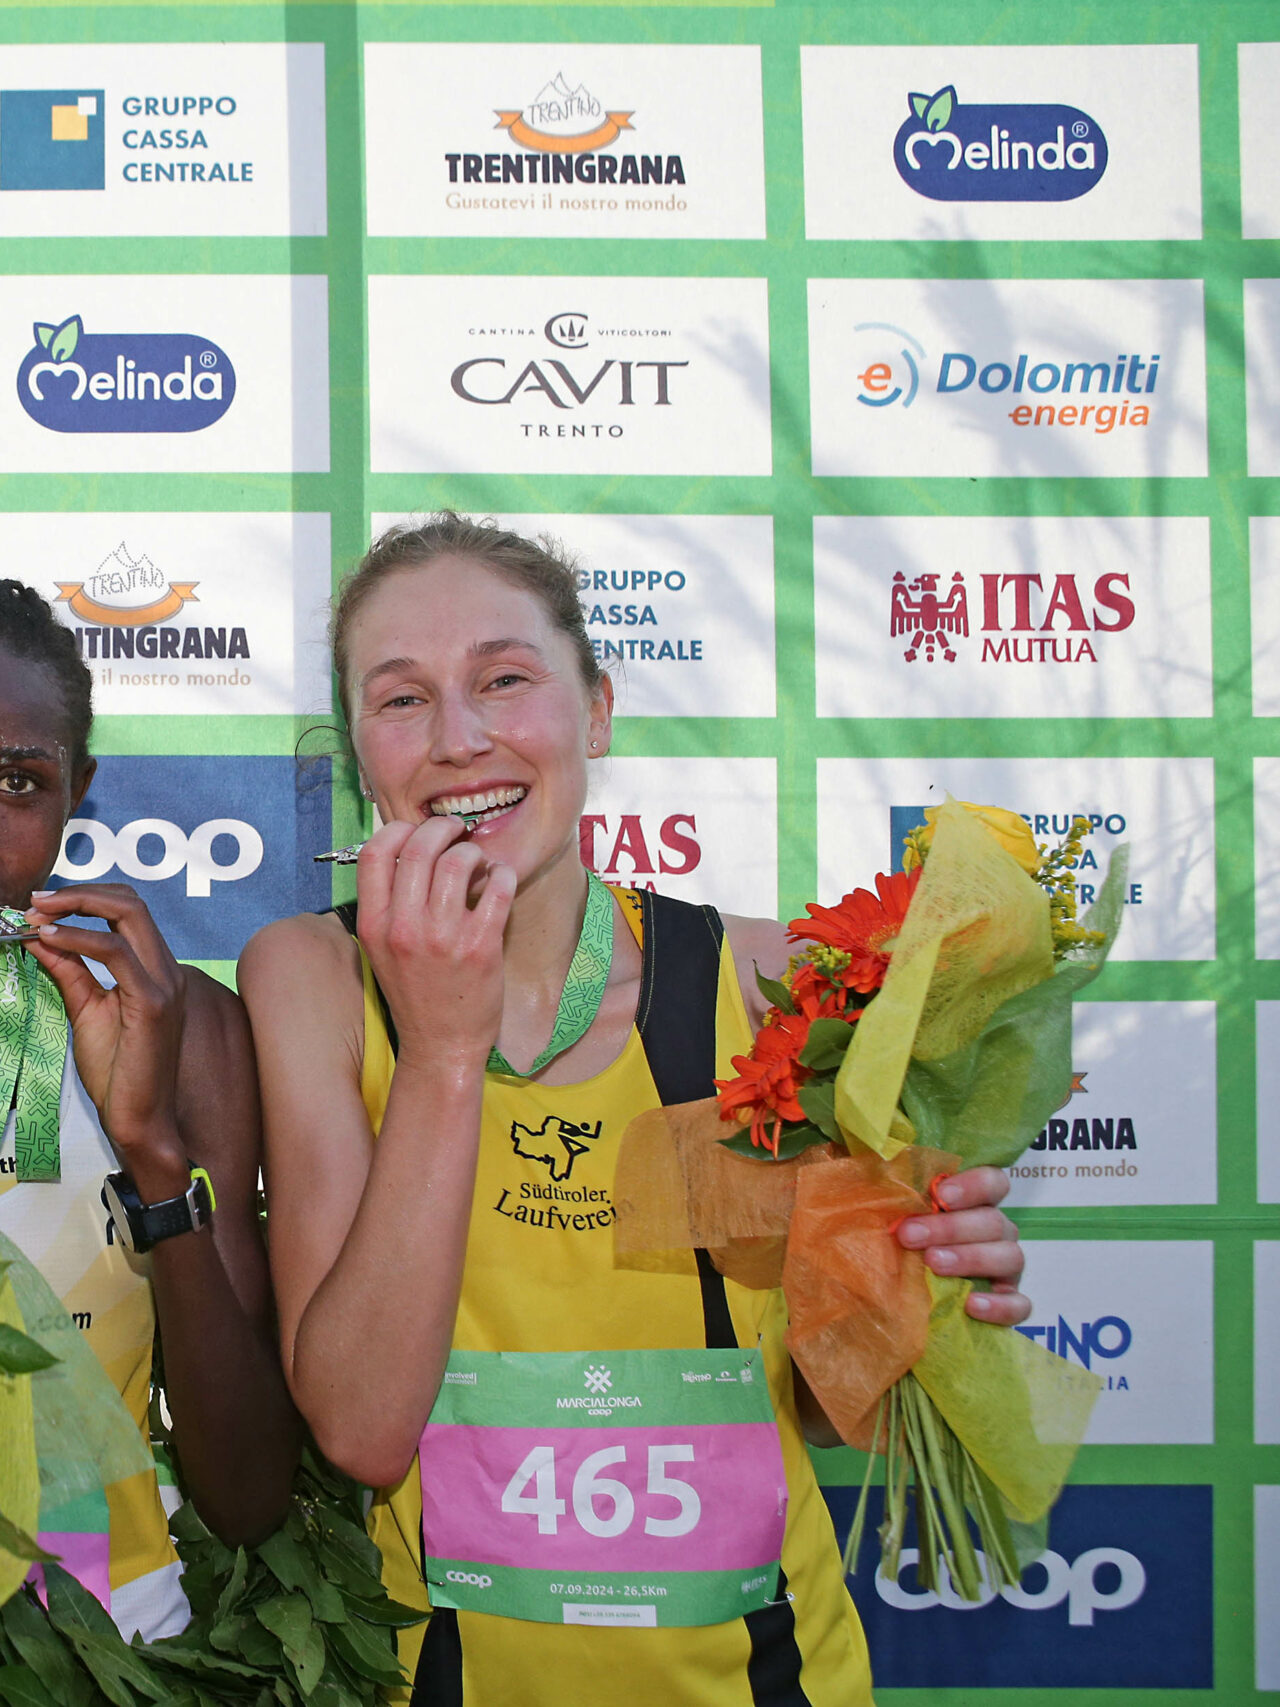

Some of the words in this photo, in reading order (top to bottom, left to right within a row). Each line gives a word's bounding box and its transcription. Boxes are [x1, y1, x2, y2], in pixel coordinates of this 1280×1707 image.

[122, 96, 238, 117] GRUPPO
[122, 129, 209, 150] CASSA
[904, 125, 1096, 171] Melinda
[122, 162, 254, 183] CENTRALE
[445, 153, 687, 185] TRENTINGRANA
[445, 192, 536, 210] Gustatevi
[541, 193, 553, 210] il
[560, 195, 619, 211] nostro
[625, 193, 688, 212] mondo
[468, 328, 536, 336] CANTINA
[28, 354, 223, 401] Melinda
[450, 357, 690, 409] CAVIT
[936, 353, 1161, 394] Dolomiti
[1008, 400, 1150, 434] energia
[521, 424, 624, 438] TRENTO
[980, 572, 1136, 633] ITAS
[587, 604, 658, 626] ASSA
[590, 639, 703, 661] ENTRALE
[980, 637, 1098, 663] MUTUA
[101, 668, 113, 686] il
[119, 671, 180, 687] nostro
[187, 668, 252, 687] mondo
[579, 813, 701, 875] TAS
[50, 818, 264, 897] oop
[1009, 1163, 1068, 1178] nostro
[1075, 1158, 1138, 1178] mondo
[556, 1396, 642, 1409] MARCIALONGA
[588, 1408, 613, 1417] coop
[501, 1444, 702, 1538] 465
[446, 1570, 493, 1589] coop
[549, 1583, 614, 1596] 07.09.2024
[623, 1585, 668, 1597] 26,5Km
